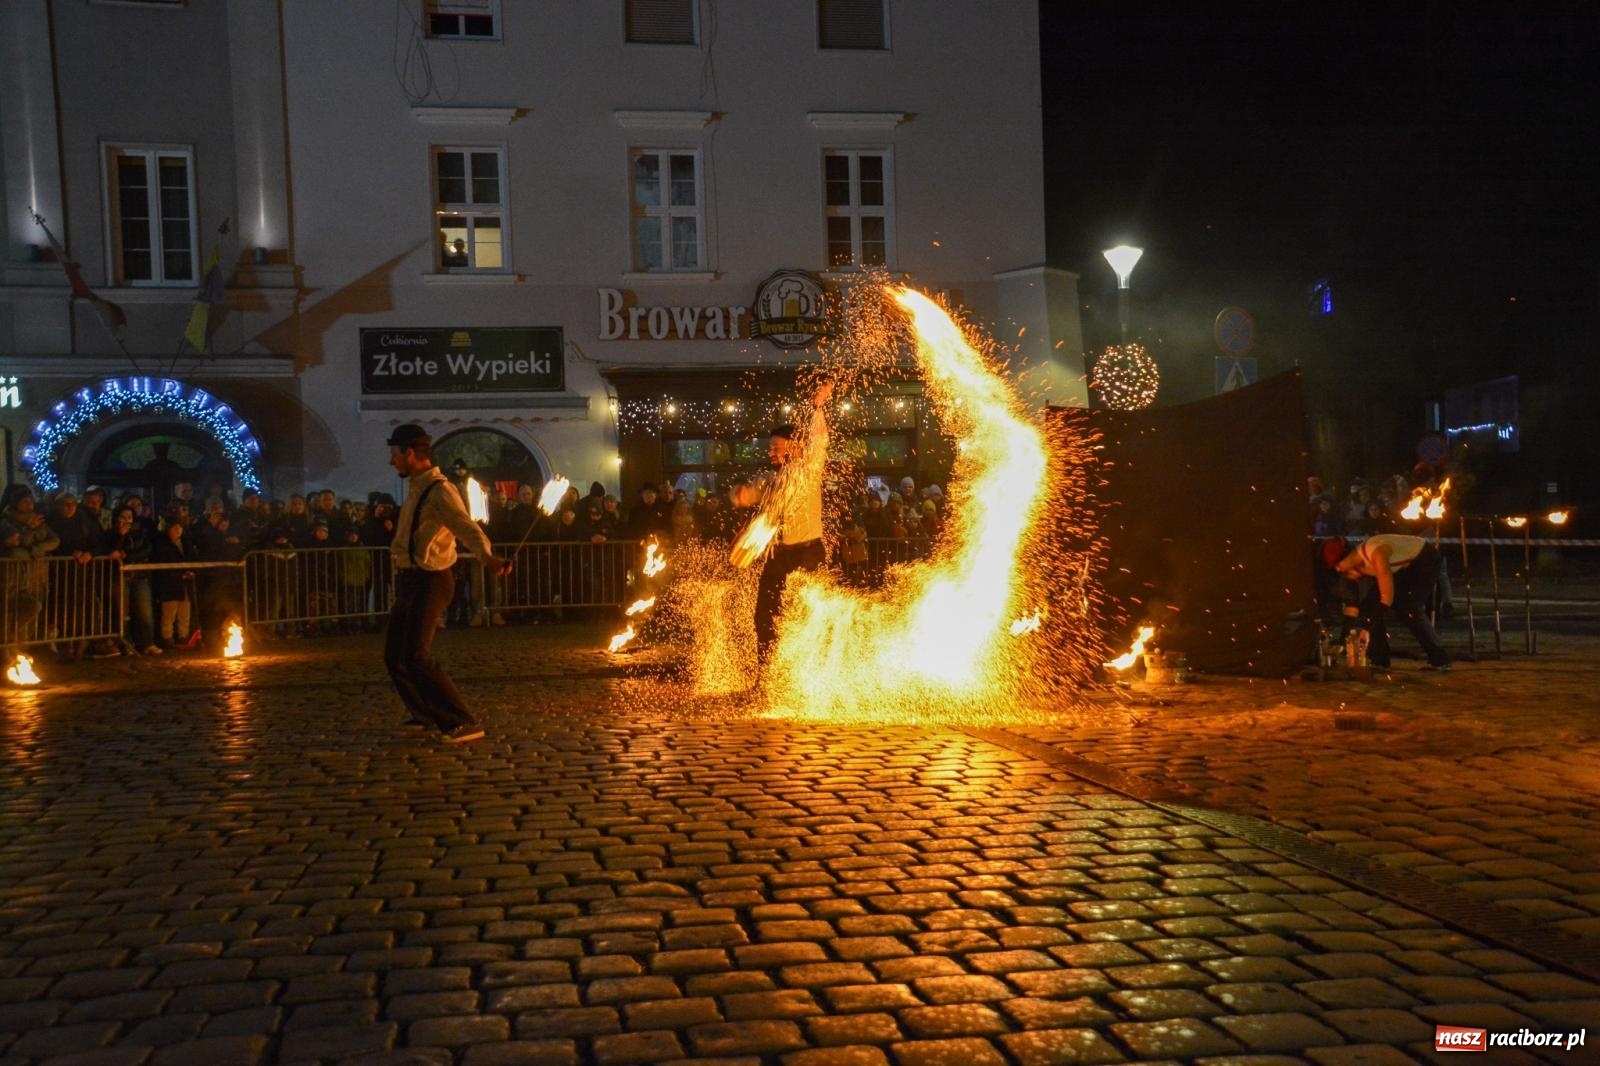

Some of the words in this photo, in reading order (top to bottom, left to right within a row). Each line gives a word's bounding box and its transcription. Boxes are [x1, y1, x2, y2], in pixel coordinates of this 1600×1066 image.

[597, 287, 746, 342] Browar
[372, 352, 439, 376] Złote
[446, 350, 551, 381] Wypieki
